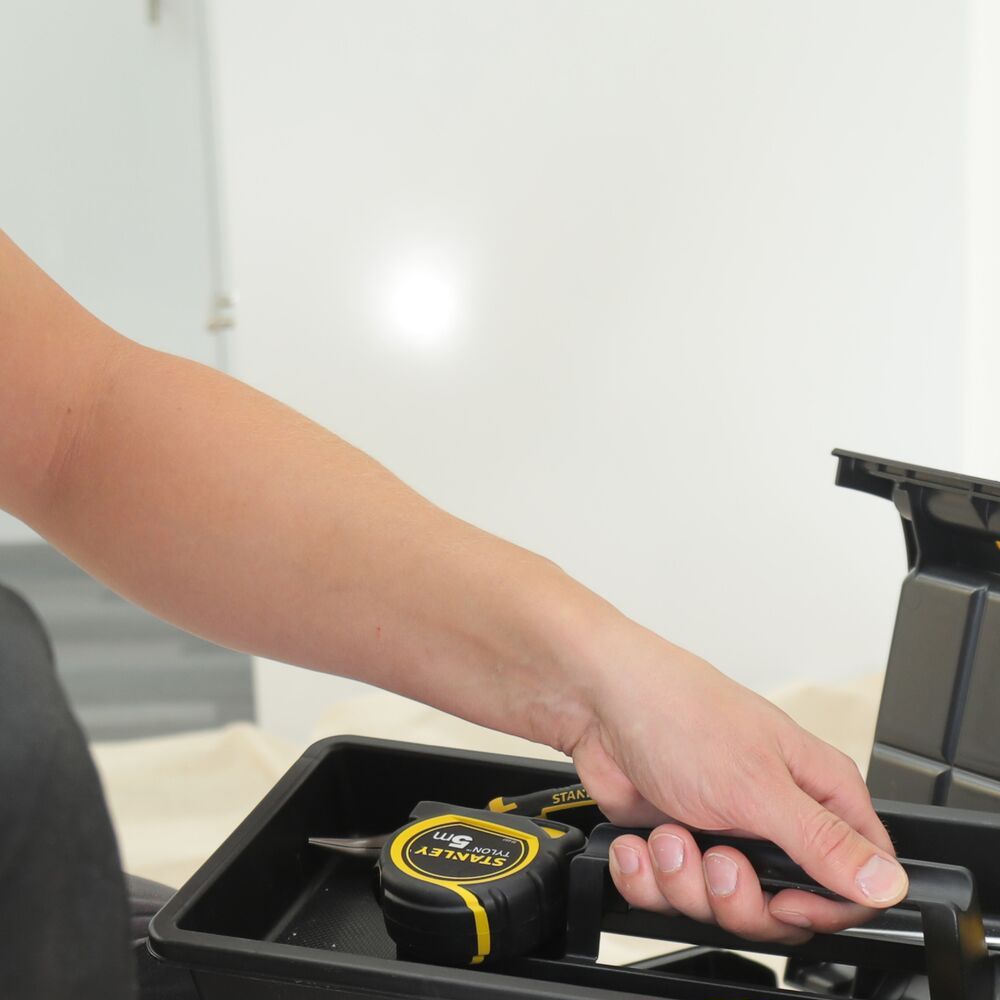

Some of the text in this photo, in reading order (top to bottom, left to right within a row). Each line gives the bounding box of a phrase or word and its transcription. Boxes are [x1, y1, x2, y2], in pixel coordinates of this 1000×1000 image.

[552, 789, 591, 804] STAN
[432, 831, 473, 849] 5m
[414, 846, 507, 867] STANLEY
